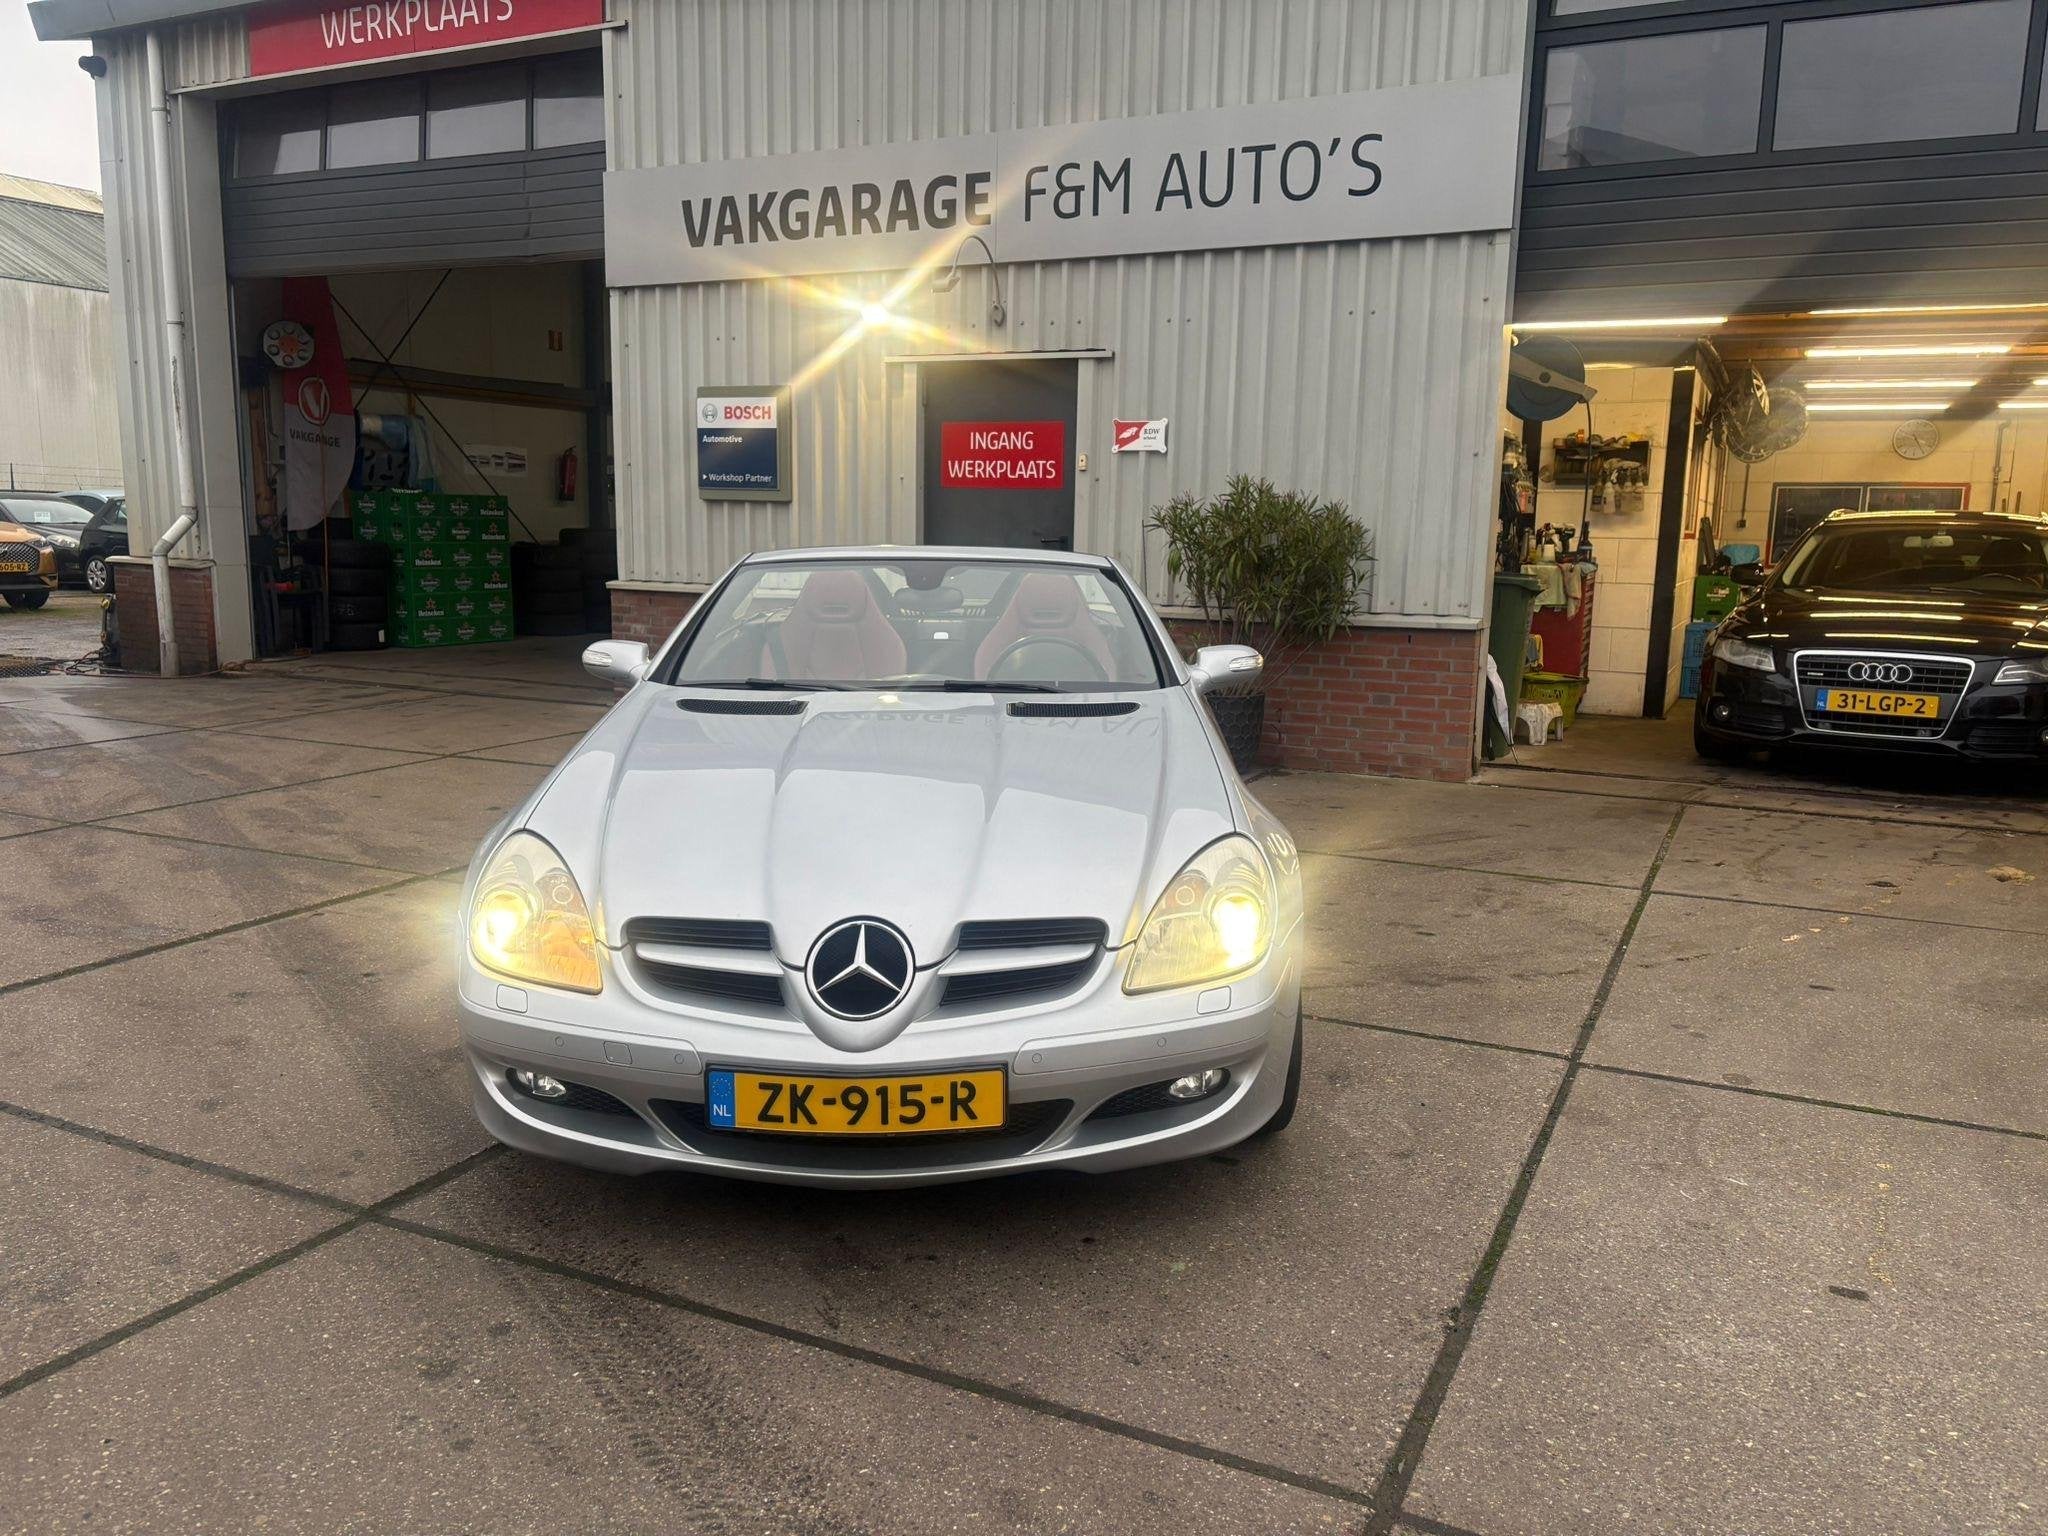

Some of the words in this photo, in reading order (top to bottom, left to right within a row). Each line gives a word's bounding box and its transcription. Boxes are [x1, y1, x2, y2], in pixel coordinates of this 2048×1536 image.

[320, 0, 513, 48] WERKPLAATS
[682, 170, 993, 248] VAKGARAGE
[1024, 157, 1132, 222] F&M
[1155, 133, 1383, 212] AUTO'S
[724, 406, 771, 420] BOSCH
[289, 428, 341, 448] VAKGAGE
[702, 434, 743, 443] Automotive
[970, 431, 1034, 450] INGANG
[708, 473, 744, 482] Workshop
[745, 474, 772, 482] Partner
[948, 460, 1056, 479] WERKPLAATS
[1837, 693, 1926, 715] 31-LGP-2
[713, 1104, 732, 1117] NL
[757, 1080, 979, 1125] ZK-915-R
